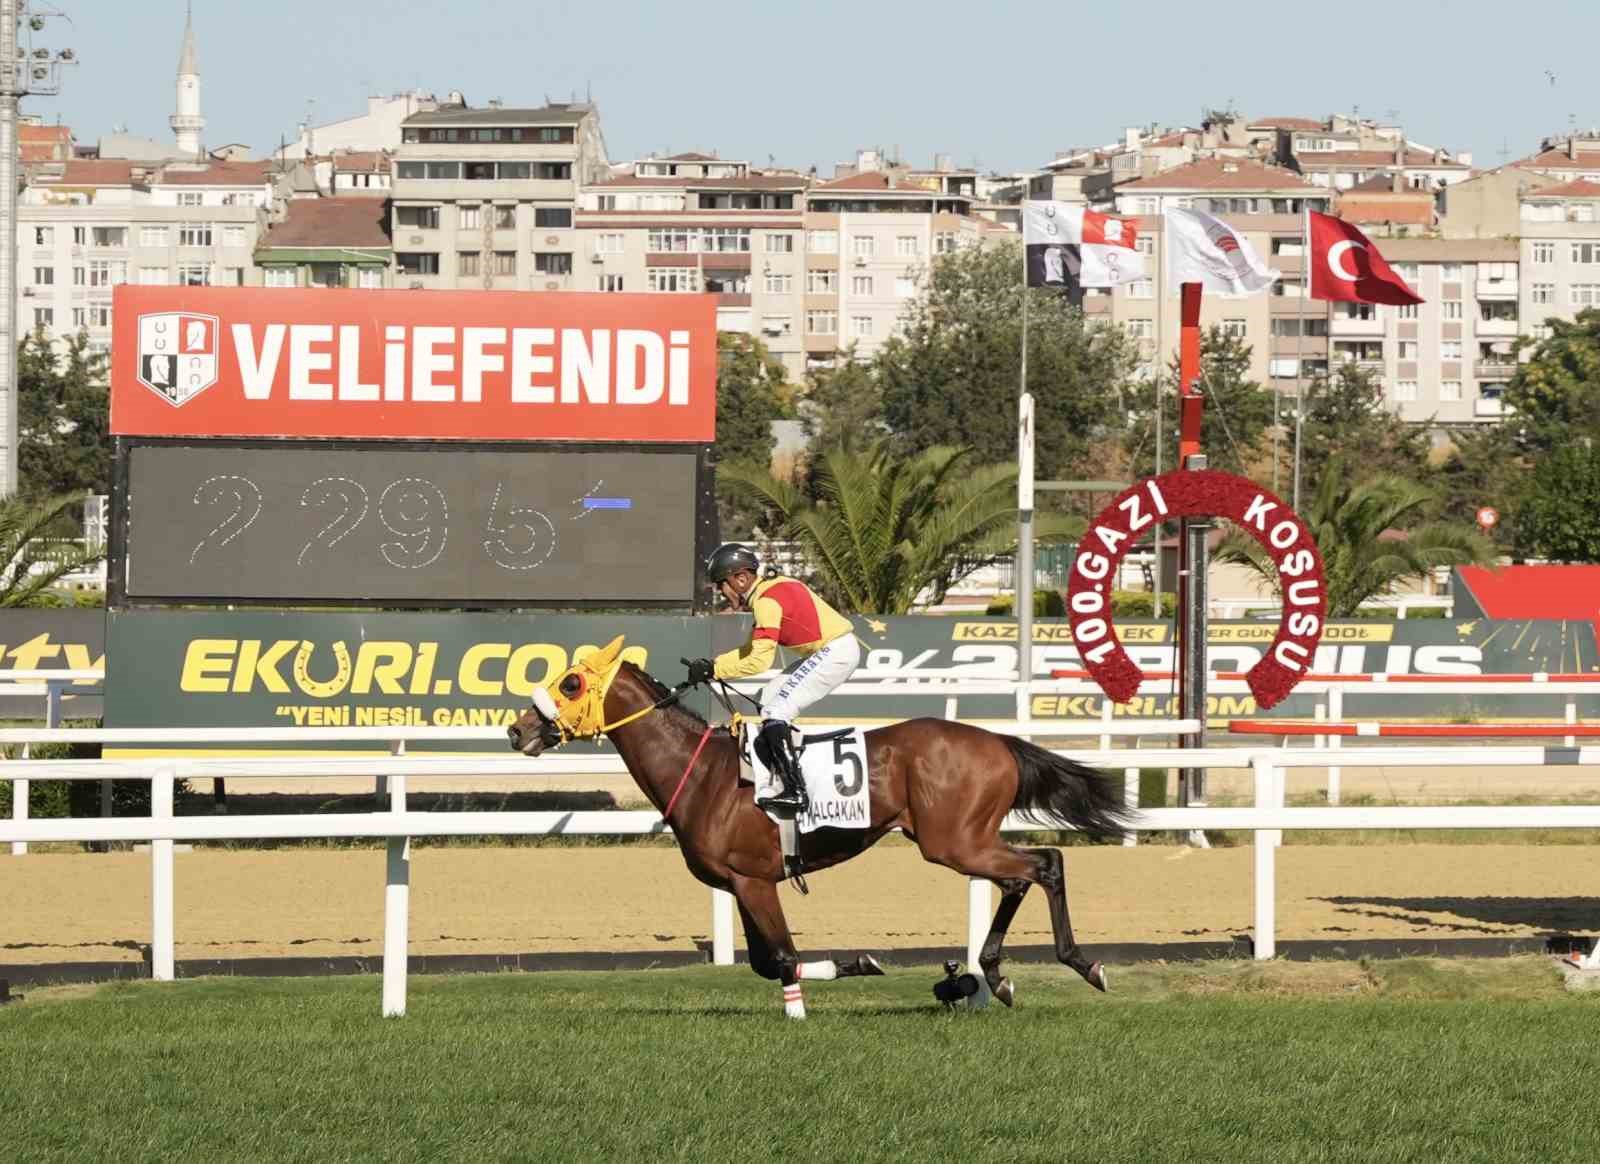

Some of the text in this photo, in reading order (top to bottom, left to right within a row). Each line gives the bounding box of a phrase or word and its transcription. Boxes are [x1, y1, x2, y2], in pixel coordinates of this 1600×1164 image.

[0, 632, 104, 700] ty
[433, 707, 526, 727] GANYA
[832, 736, 864, 797] 5
